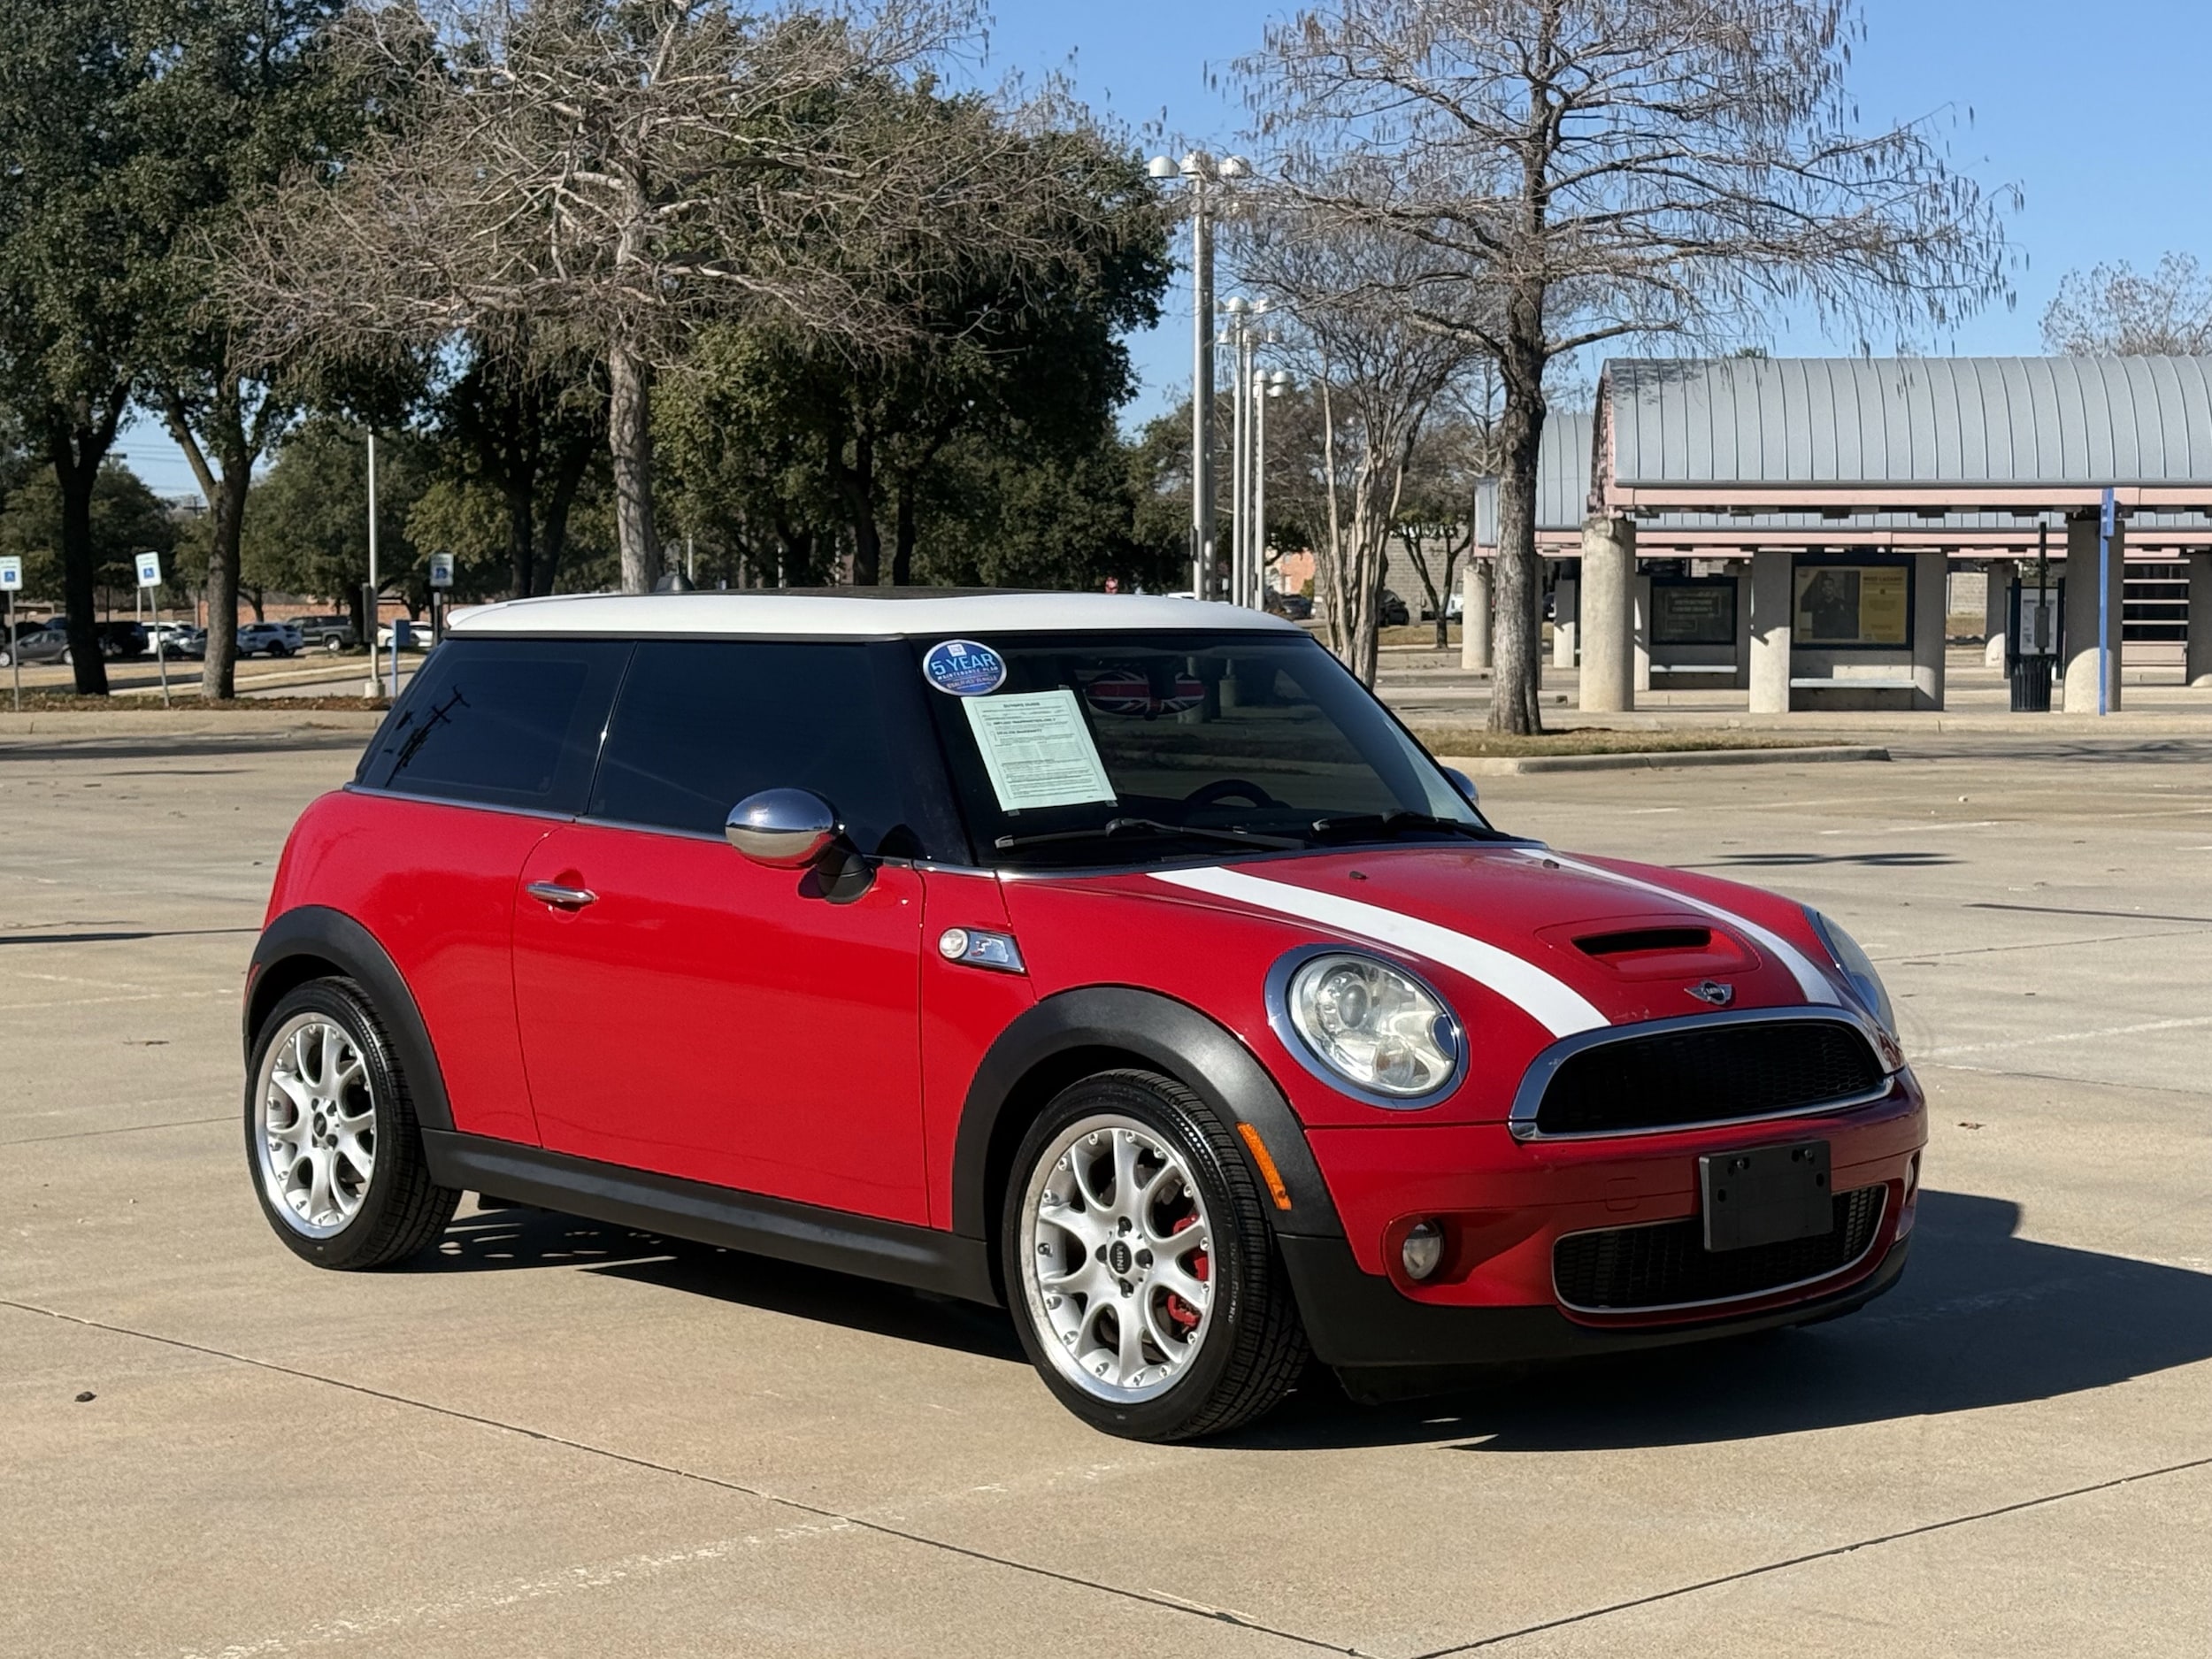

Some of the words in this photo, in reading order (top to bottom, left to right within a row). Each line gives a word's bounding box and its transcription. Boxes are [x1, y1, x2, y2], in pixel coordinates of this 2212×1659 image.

[931, 660, 946, 675] 5
[946, 653, 996, 672] YEAR
[1116, 1245, 1125, 1271] MINI
